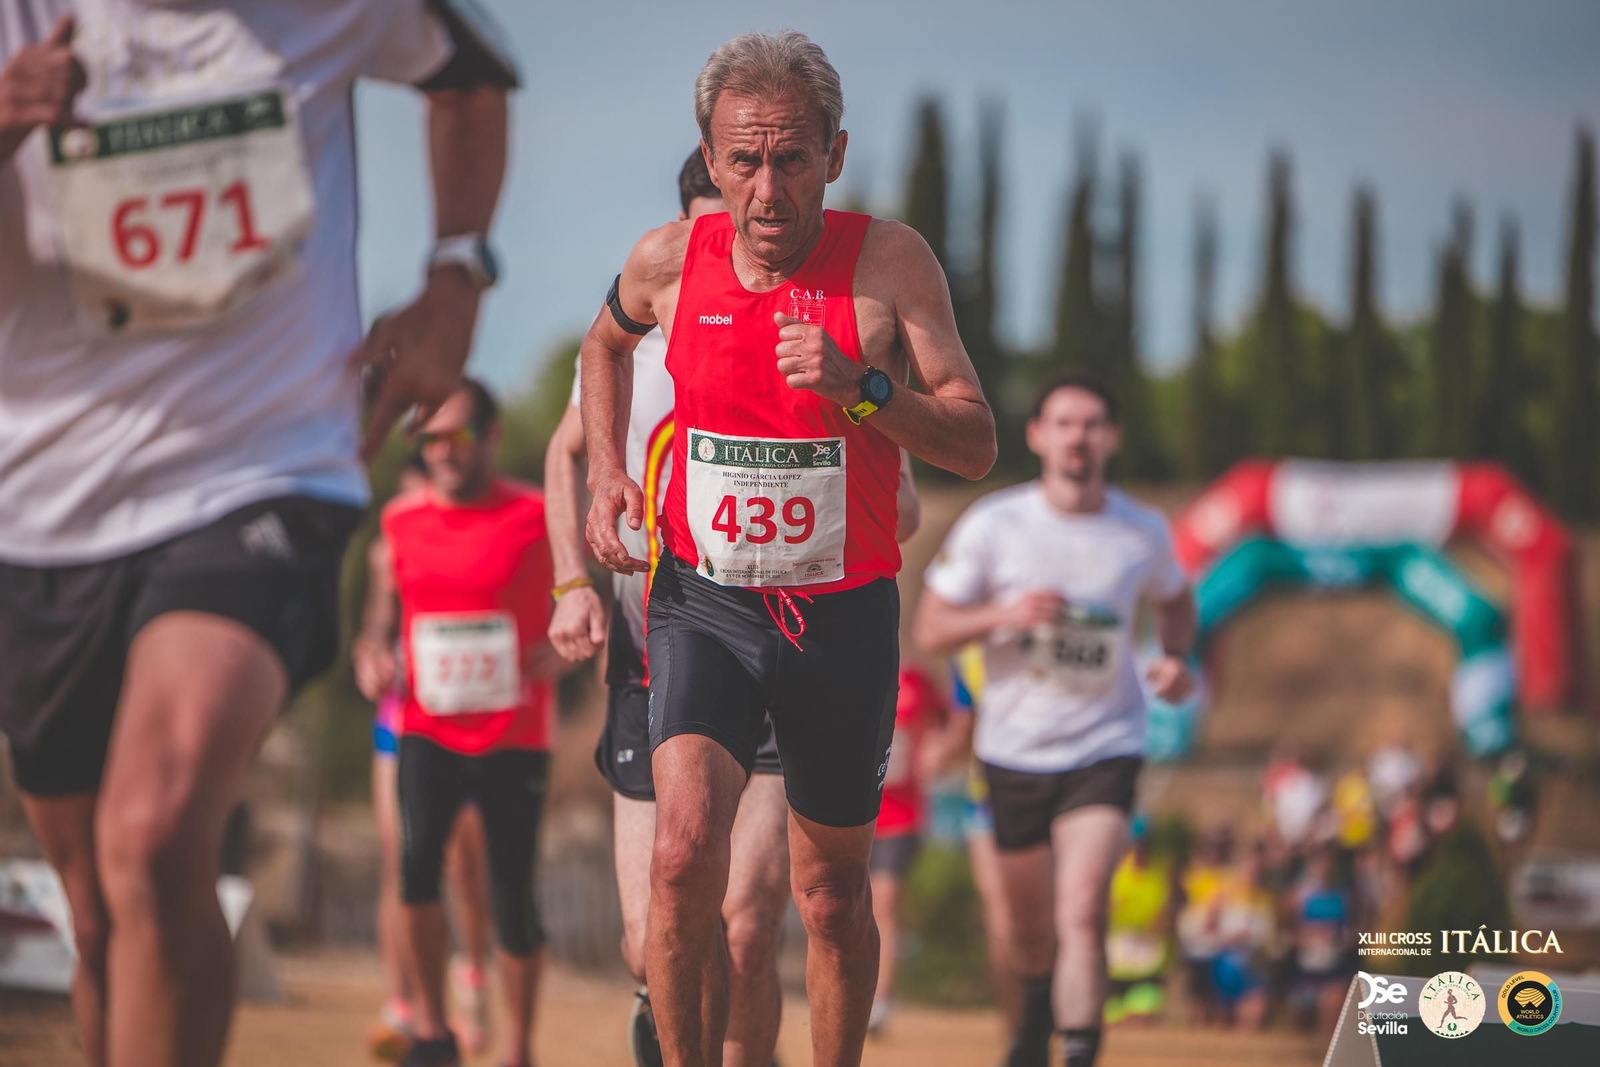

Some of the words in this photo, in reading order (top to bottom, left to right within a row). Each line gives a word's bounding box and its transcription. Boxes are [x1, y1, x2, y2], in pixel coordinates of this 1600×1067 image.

[110, 177, 270, 271] 671
[790, 288, 827, 300] C.A.B.
[699, 314, 733, 325] mobel
[724, 442, 800, 464] ITÁLICA
[722, 471, 749, 480] HIGINIO
[750, 473, 777, 481] GARCIA
[733, 480, 789, 488] INDEPENDIENTE
[711, 494, 816, 545] 439
